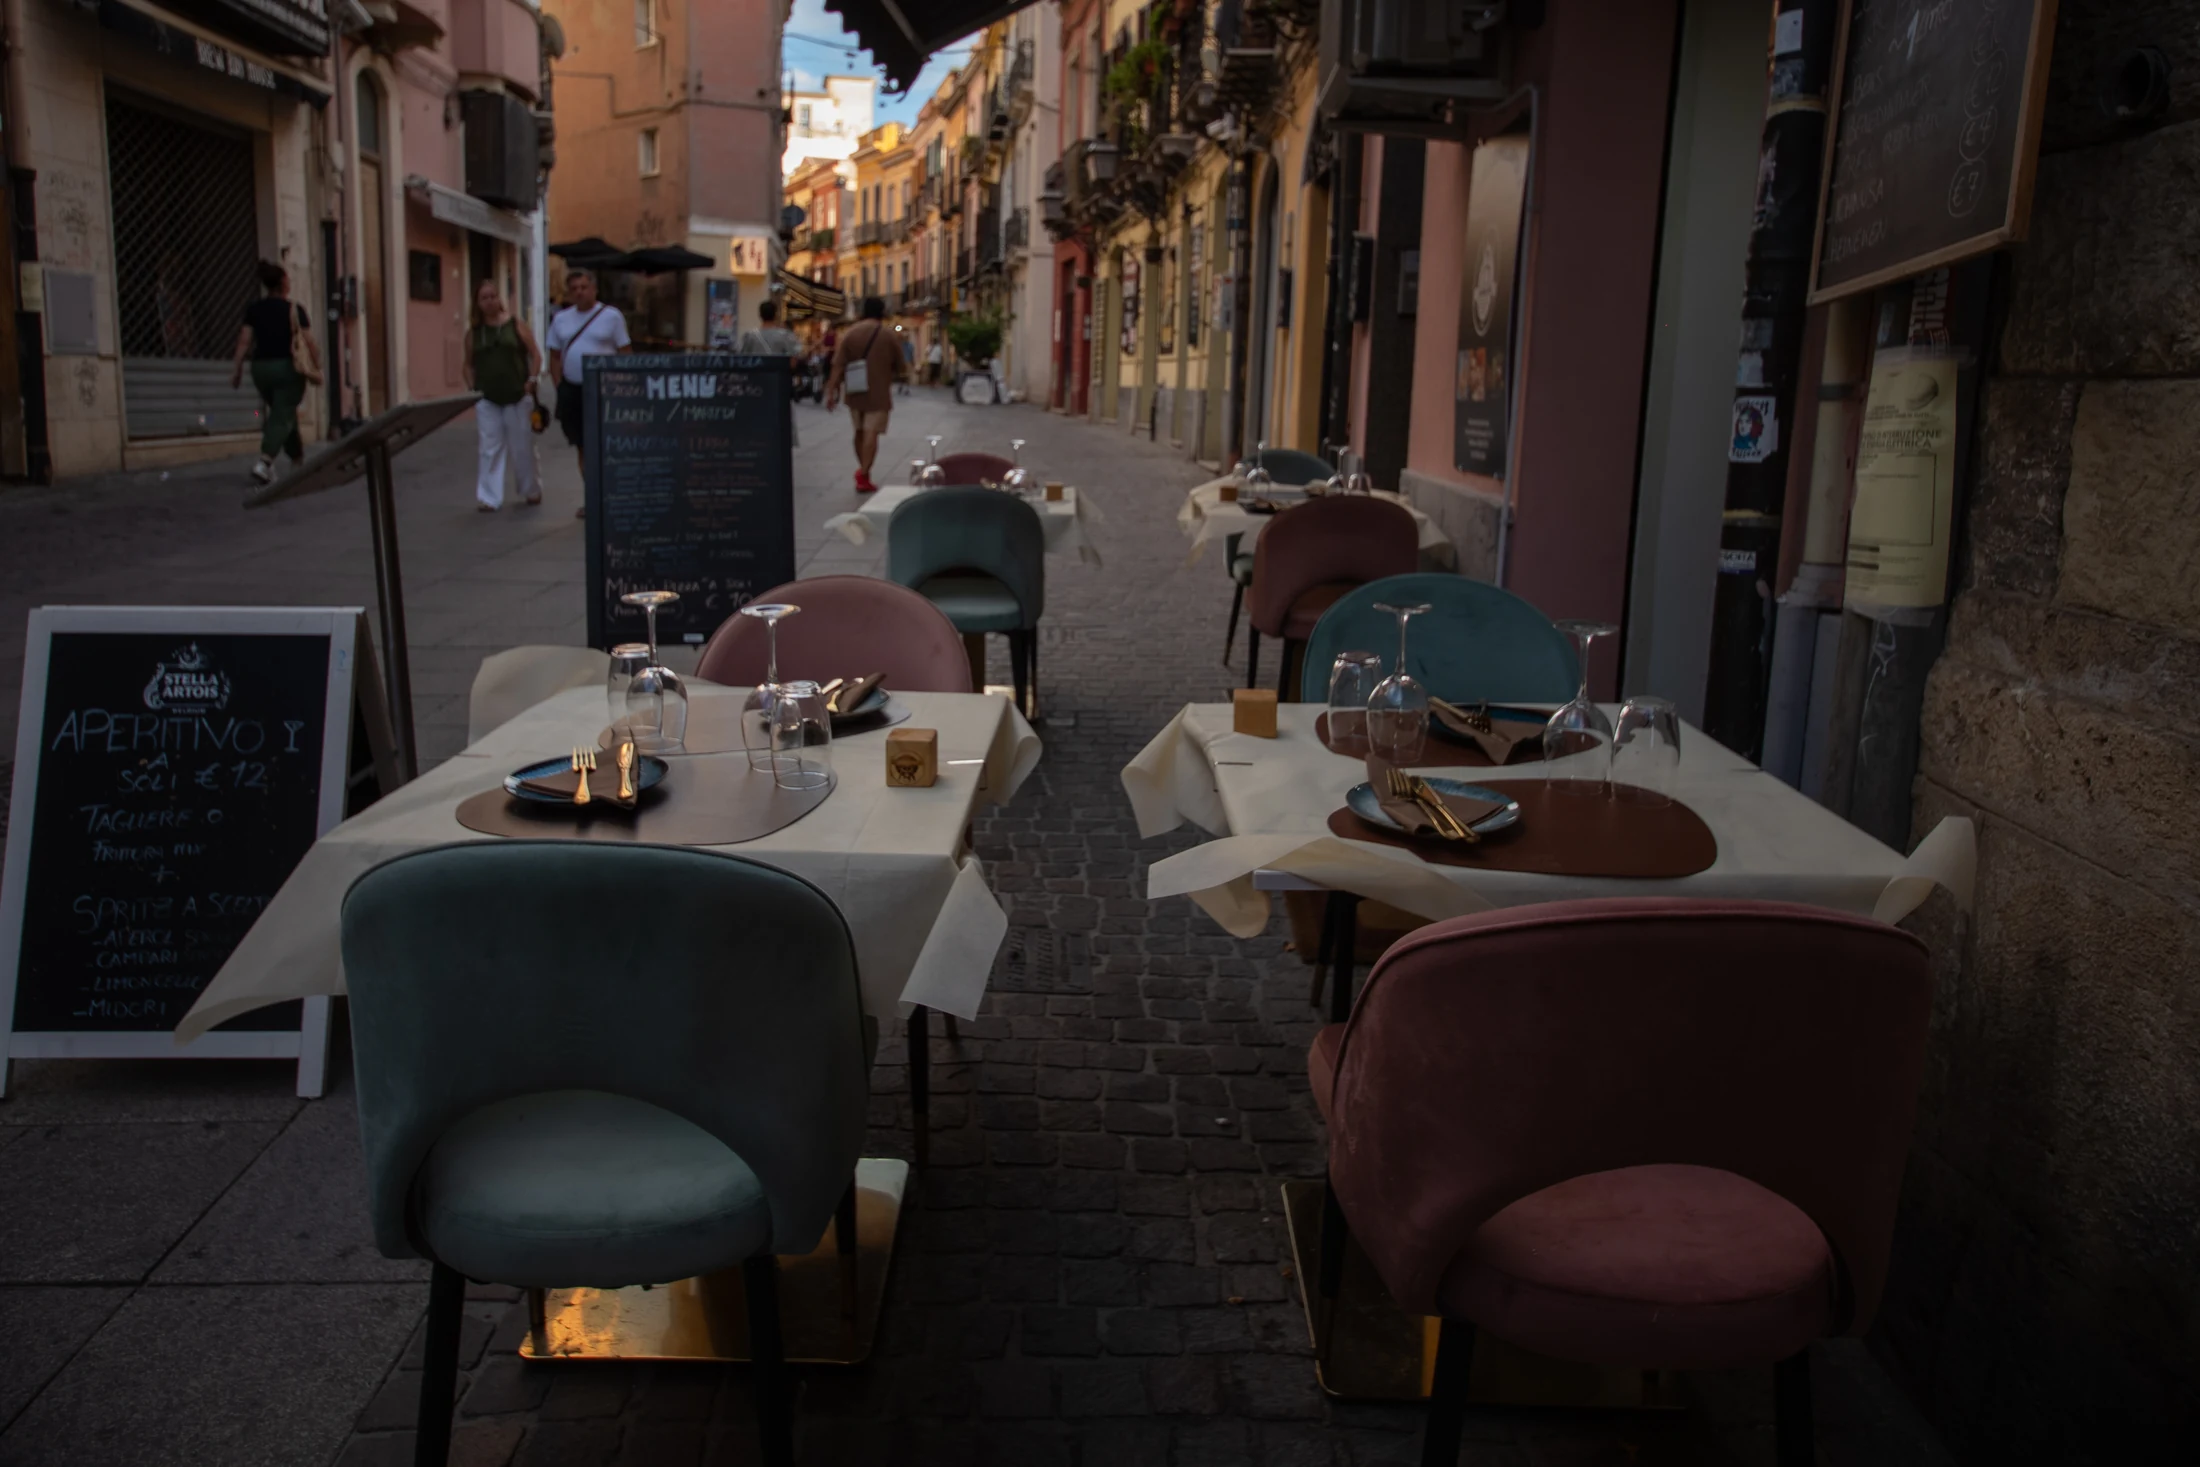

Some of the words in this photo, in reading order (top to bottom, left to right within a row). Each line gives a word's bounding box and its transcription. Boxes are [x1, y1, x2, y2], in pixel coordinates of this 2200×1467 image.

[164, 673, 219, 686] STELLA
[162, 685, 219, 699] ARTOIS
[52, 707, 266, 754] APERITIVO
